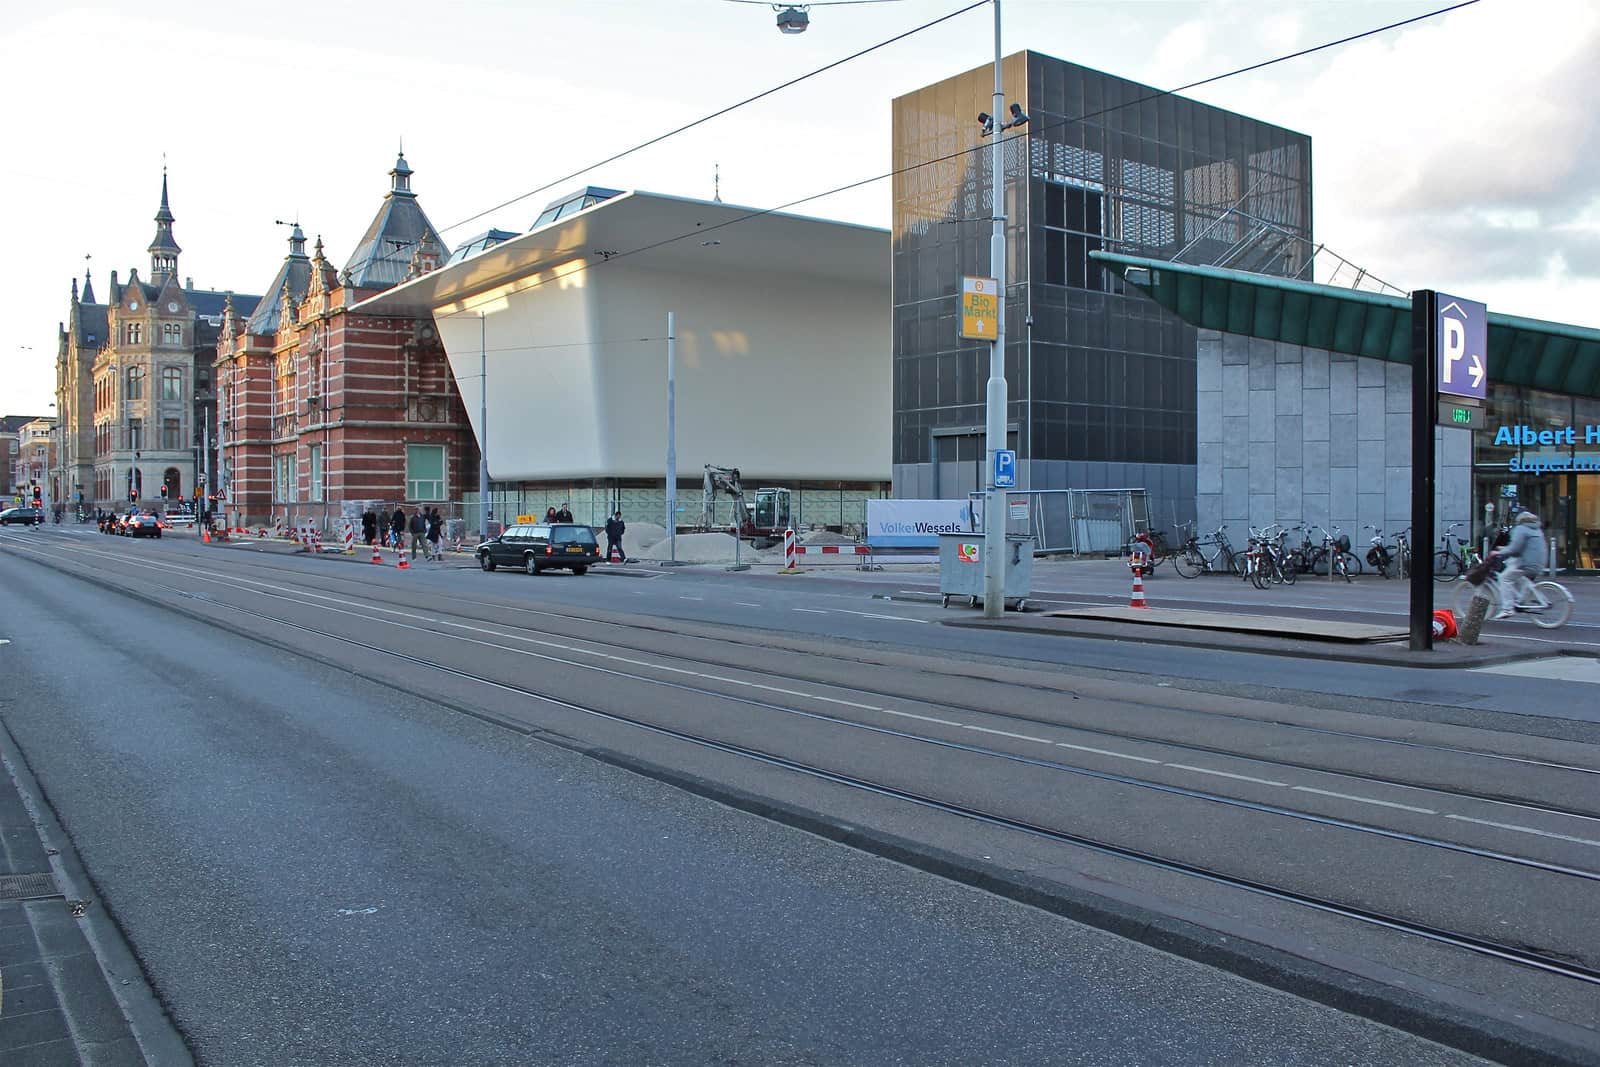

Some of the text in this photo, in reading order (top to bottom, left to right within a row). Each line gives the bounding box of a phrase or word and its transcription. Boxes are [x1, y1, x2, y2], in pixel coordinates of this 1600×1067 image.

[972, 295, 990, 307] Bio
[964, 304, 996, 319] Markt
[1443, 318, 1464, 383] P
[1494, 425, 1576, 446] Albert
[1000, 453, 1011, 472] P
[880, 522, 961, 534] VolkerWessels
